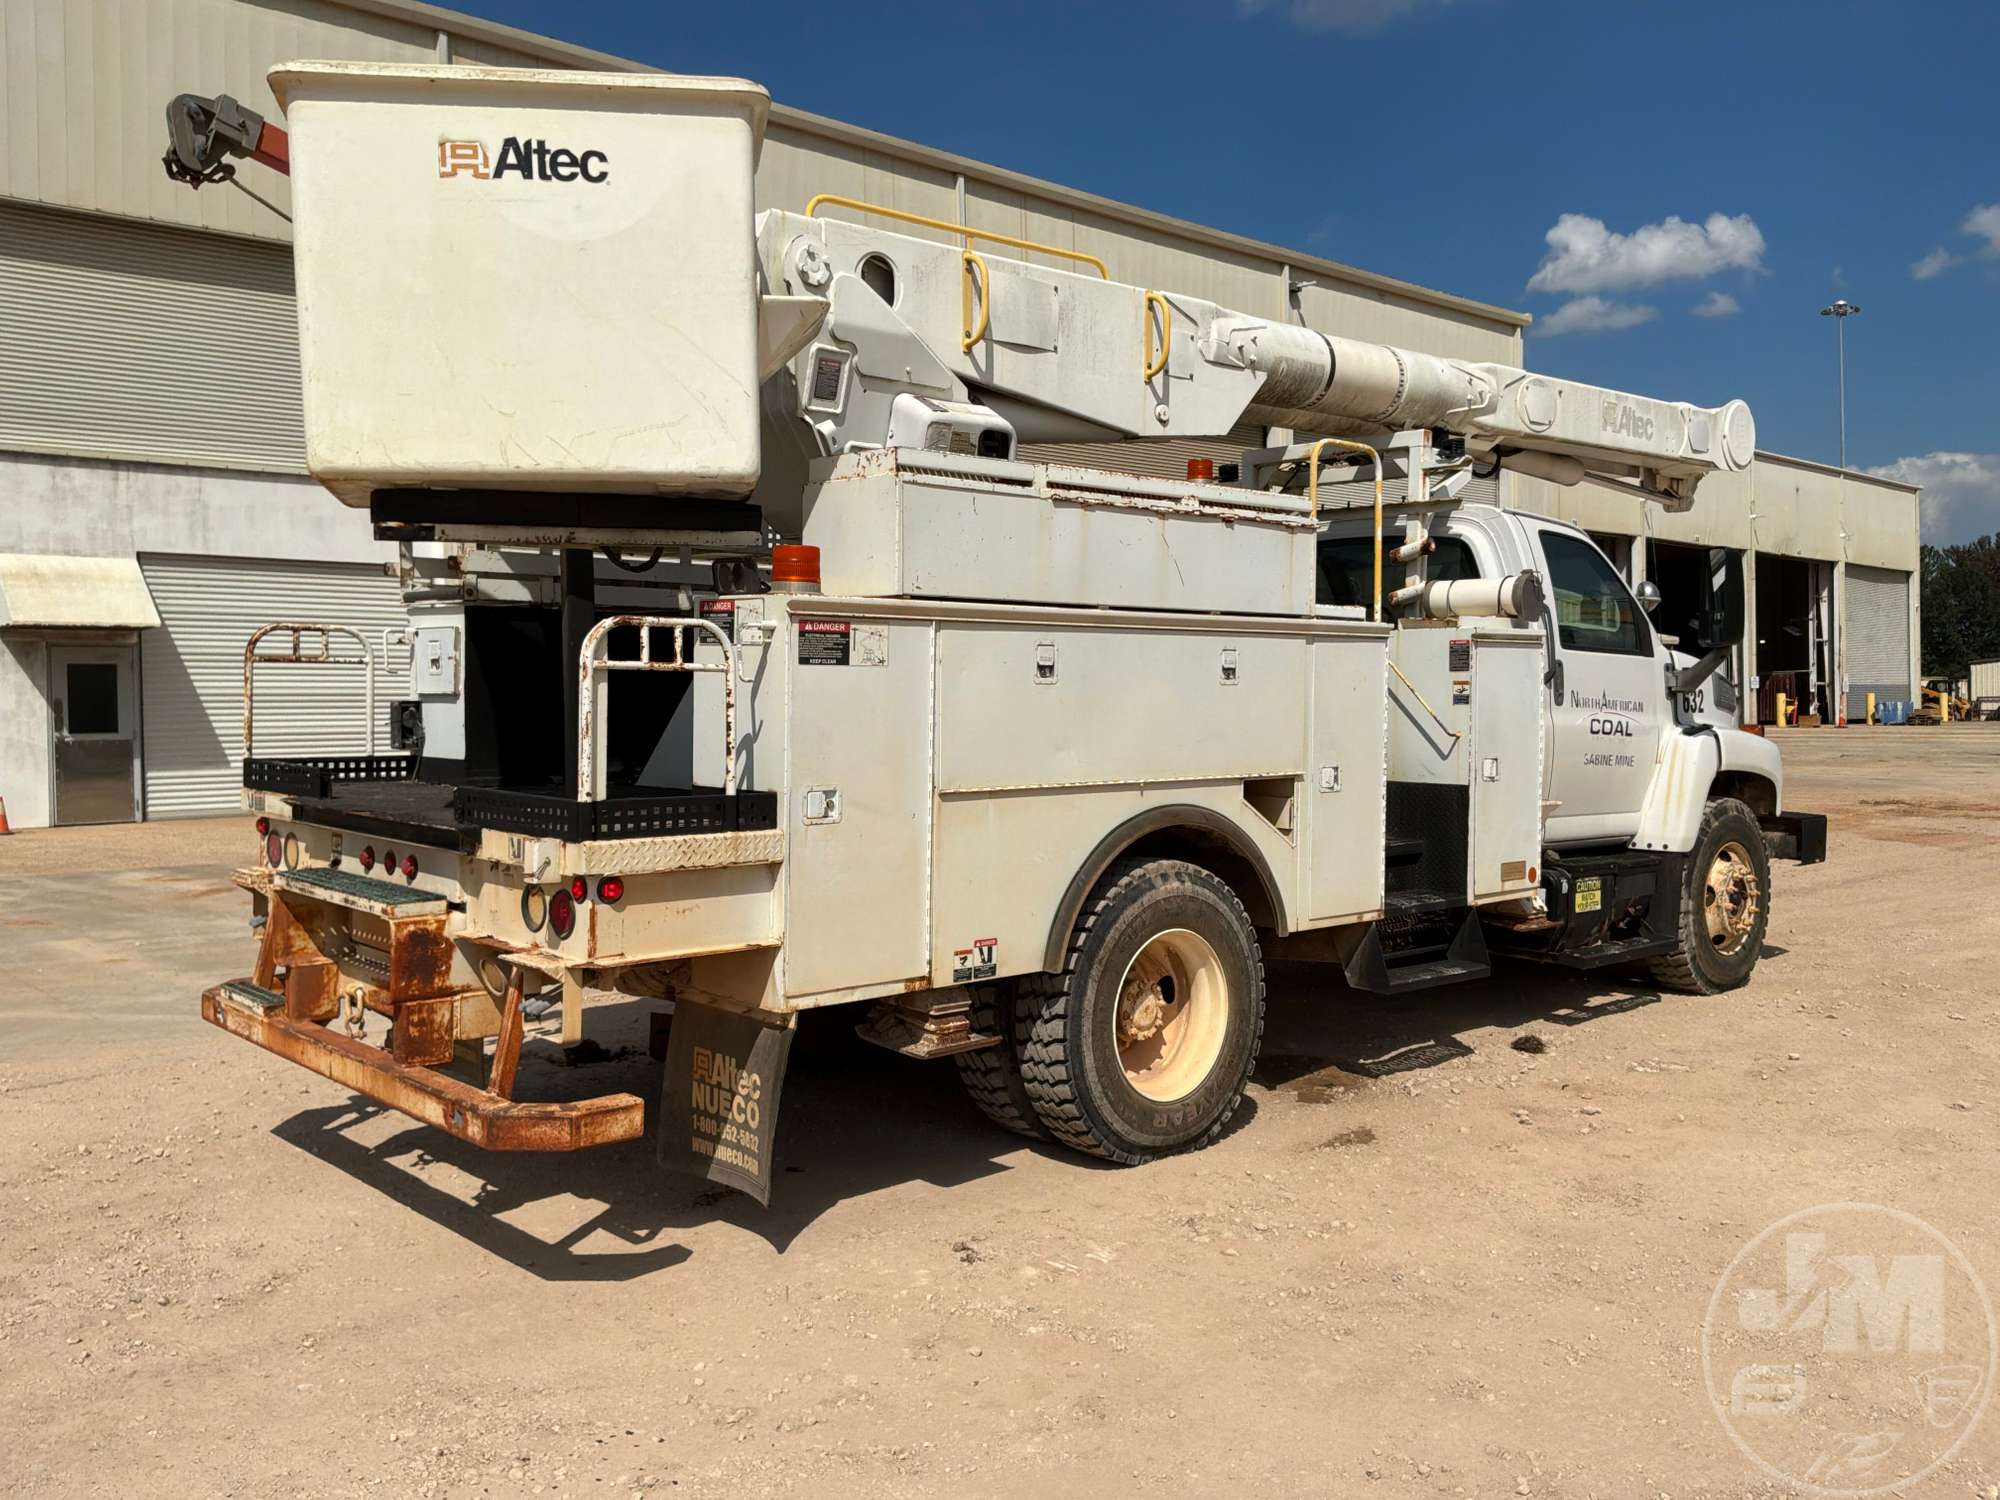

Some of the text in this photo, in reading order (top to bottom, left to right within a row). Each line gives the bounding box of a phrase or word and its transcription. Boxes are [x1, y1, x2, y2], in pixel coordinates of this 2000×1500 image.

[493, 136, 609, 183] Altec
[1619, 405, 1654, 441] Altec
[813, 622, 846, 631] DANGER
[1682, 688, 1705, 713] 632
[1590, 718, 1633, 737] COAL
[1583, 752, 1635, 768] SABINE MINE
[1576, 879, 1601, 892] CAUTION
[711, 1053, 761, 1100] Altec
[691, 1081, 760, 1129] NUECO
